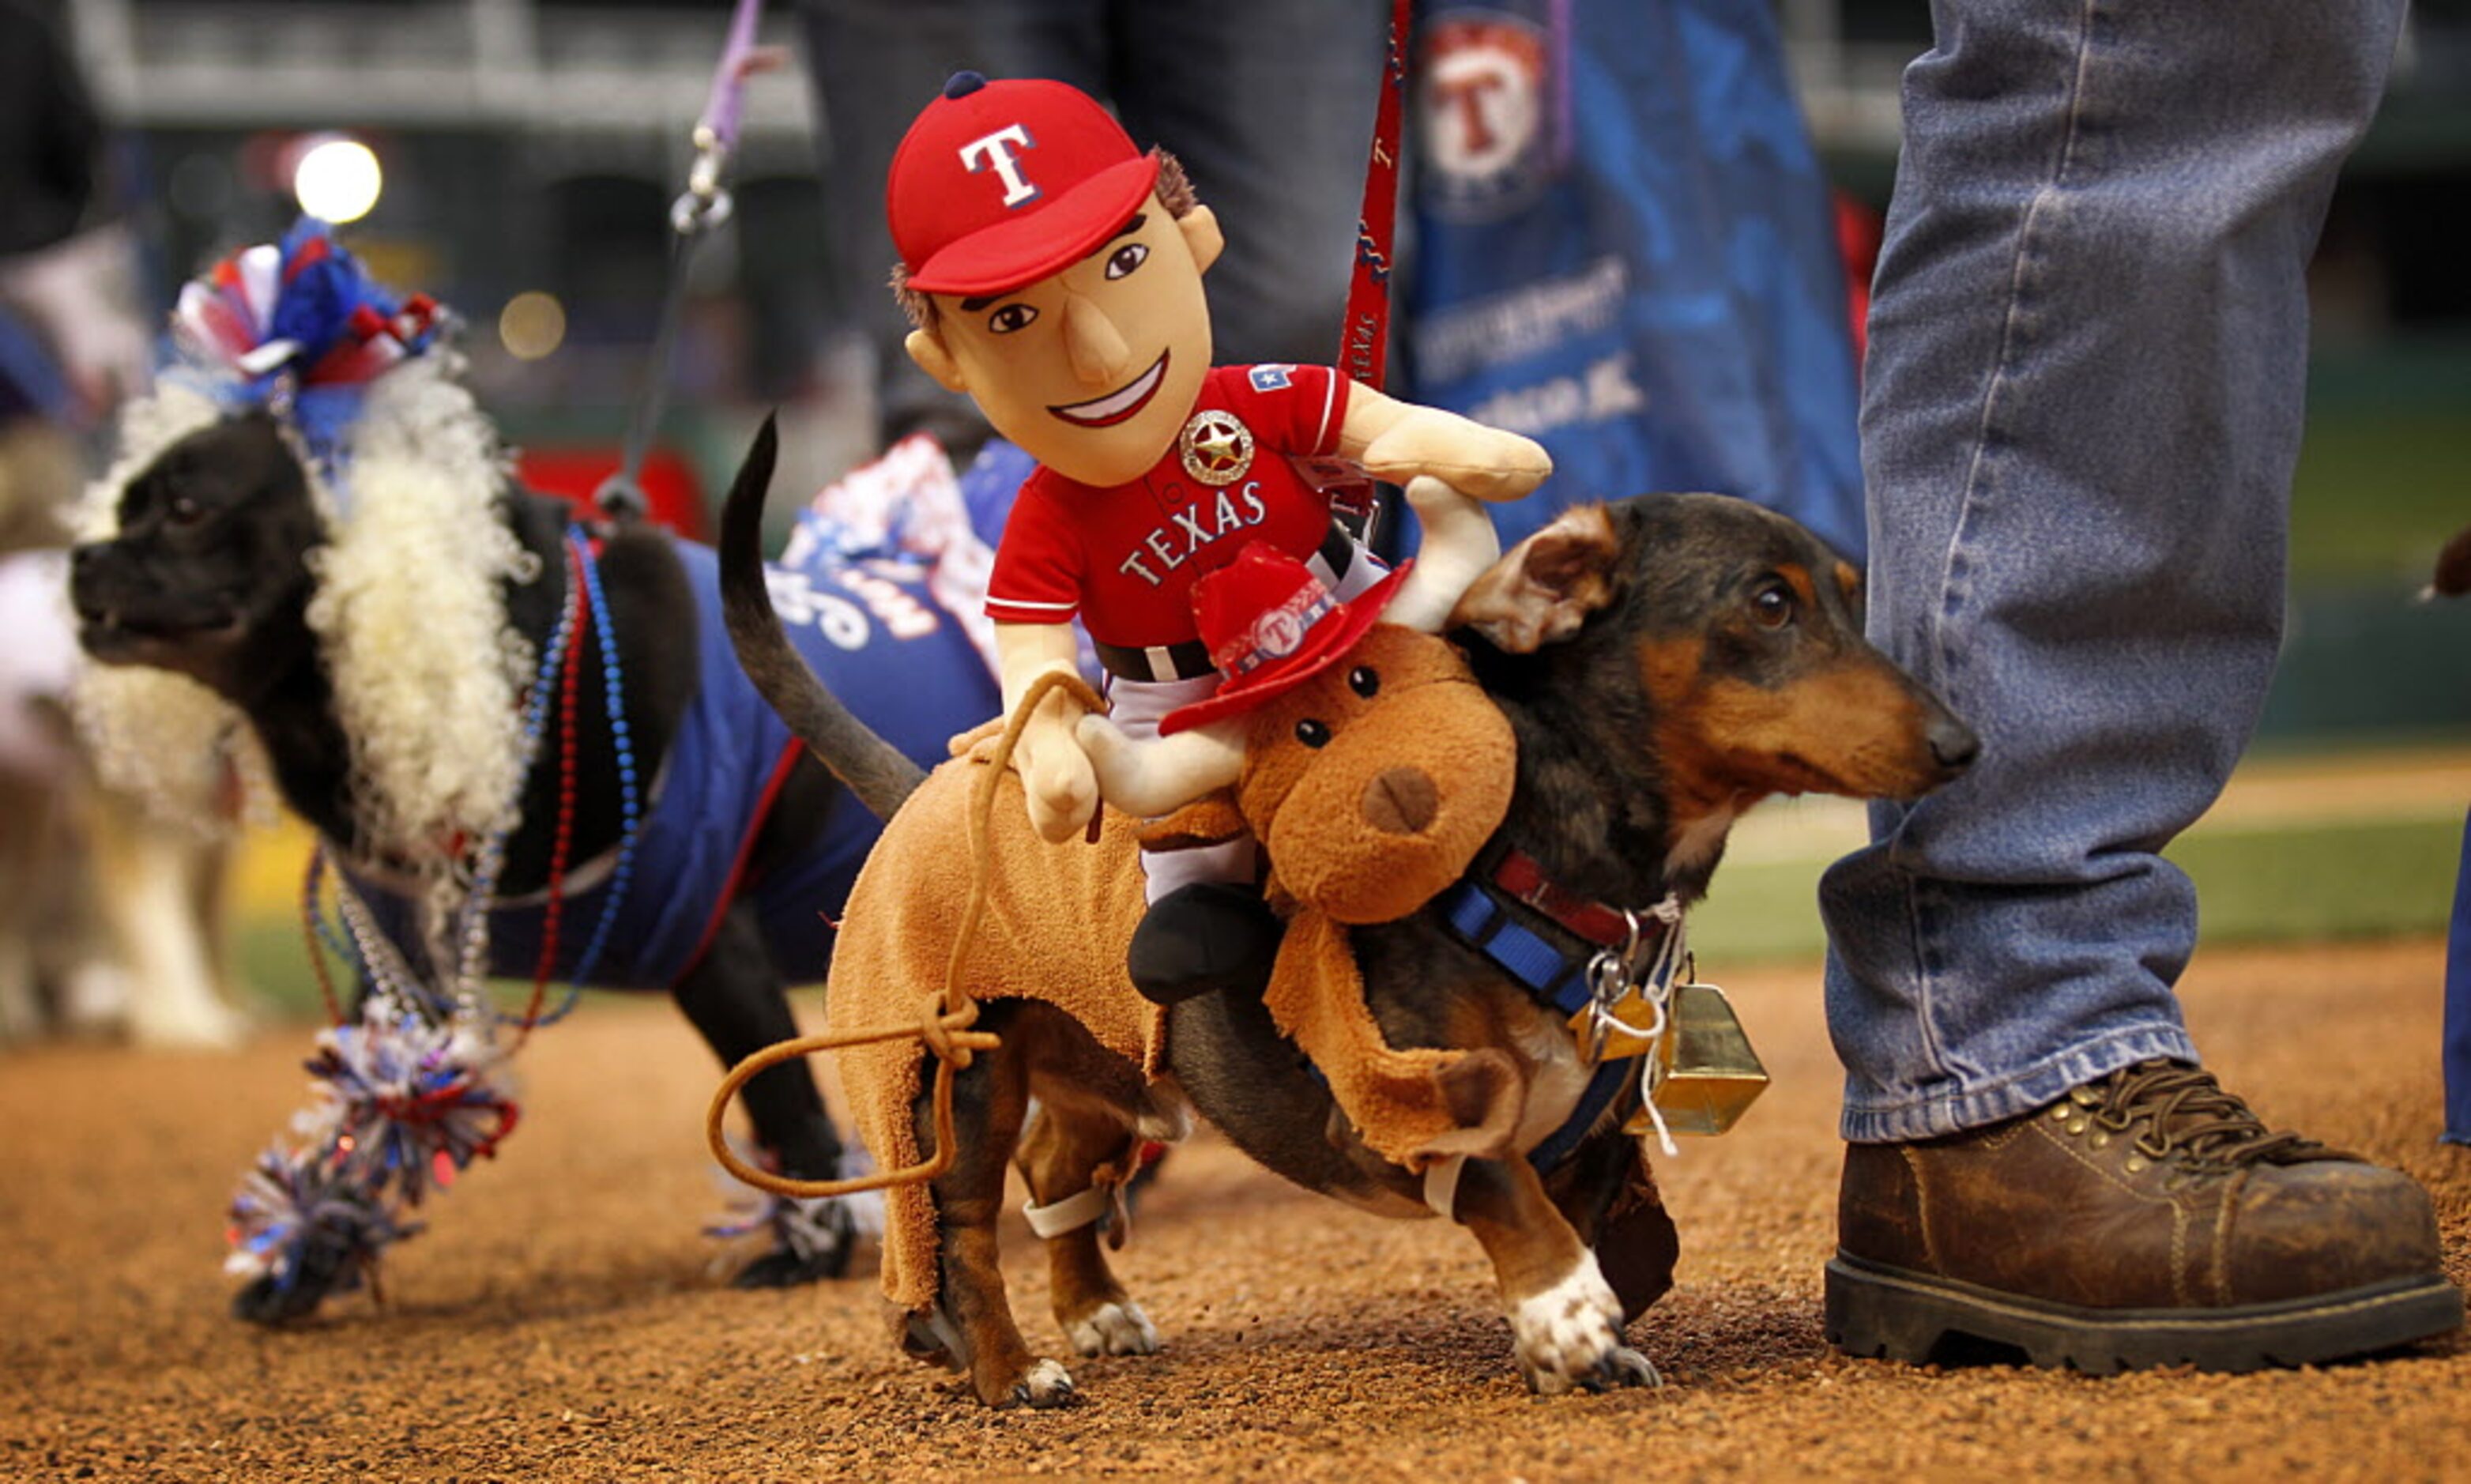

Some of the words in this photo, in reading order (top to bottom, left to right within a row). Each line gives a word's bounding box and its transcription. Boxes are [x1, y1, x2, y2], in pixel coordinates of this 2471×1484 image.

[1432, 68, 1503, 155] T
[958, 122, 1043, 209] T
[1373, 137, 1392, 170] T
[1352, 311, 1378, 379] TEXAS
[1118, 480, 1266, 586] TEXAS
[1265, 617, 1292, 647] T
